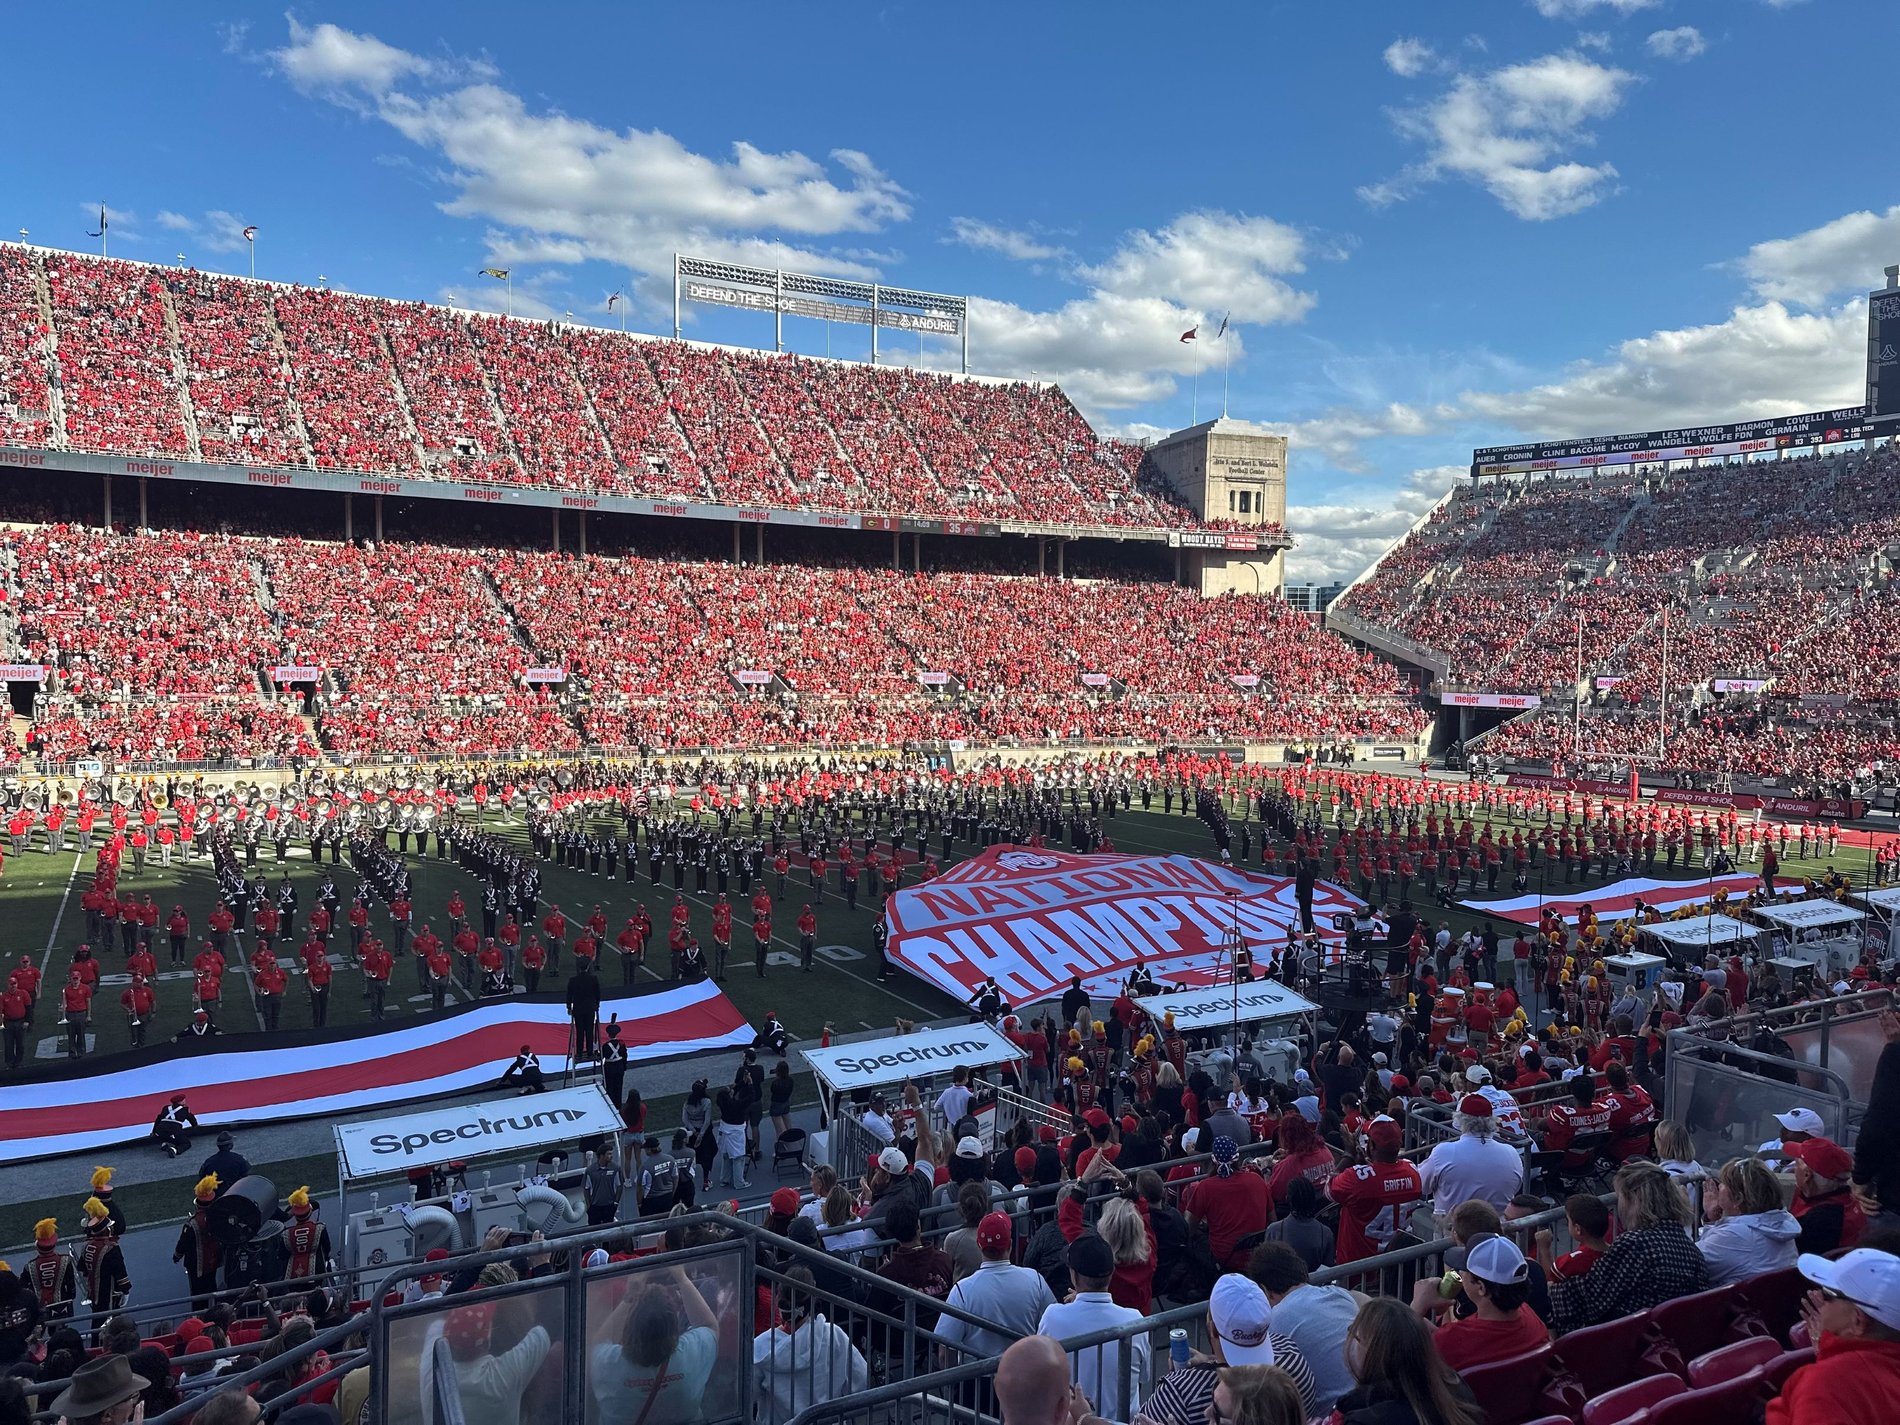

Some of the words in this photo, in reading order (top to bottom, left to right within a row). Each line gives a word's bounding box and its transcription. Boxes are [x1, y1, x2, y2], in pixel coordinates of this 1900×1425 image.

[690, 284, 737, 304] DEFEND
[739, 292, 762, 306] THE
[1872, 296, 1900, 309] DEFEN
[1881, 304, 1899, 313] THE
[912, 317, 956, 332] ANDURIL
[1832, 407, 1866, 419] WELLS
[1786, 413, 1825, 426] COVELLI
[1735, 420, 1775, 433] HARMON
[1765, 423, 1809, 436] GERMAIN
[1617, 433, 1648, 441] DIAMOND
[1662, 431, 1679, 440] LES
[1681, 427, 1724, 438] WEXNER
[1699, 433, 1733, 443] WOLFE
[1734, 431, 1753, 440] FDN
[1810, 435, 1823, 444] 393
[1611, 442, 1641, 451] McCOY
[1647, 437, 1693, 448] WANDELL
[1739, 440, 1769, 451] meijer
[1542, 449, 1566, 458] CLINE
[1570, 445, 1607, 455] BACOME
[1631, 451, 1660, 461] meijer
[1684, 446, 1715, 457] meijer
[1475, 455, 1497, 463] AUER
[1503, 452, 1533, 461] CRONIN
[1580, 455, 1607, 465] meijer
[126, 460, 174, 479] meijer
[1485, 463, 1510, 473] meijer
[1531, 460, 1558, 469] meijer
[247, 471, 292, 487] meijer
[360, 479, 402, 495] meijer
[464, 487, 503, 502] meijer
[562, 495, 598, 509] meijer
[653, 502, 687, 516] meijer
[738, 509, 770, 522] meijer
[818, 515, 849, 528] meijer
[883, 518, 890, 529] 0
[949, 522, 961, 534] 35
[1181, 534, 1202, 543] WOODY
[1205, 535, 1225, 544] HAYES
[0, 667, 38, 679] meijer
[280, 669, 314, 681] meijer
[531, 670, 559, 682] meijer
[742, 672, 766, 683] meijer
[1084, 675, 1107, 684] meijer
[1454, 693, 1480, 704] meijer
[1499, 695, 1526, 706] meijer
[1513, 777, 1540, 786] DEFEND
[1603, 786, 1630, 795] ANDURI
[1663, 791, 1693, 801] DEFEND
[1694, 795, 1709, 803] THE
[1775, 803, 1810, 813] ANDURIL
[1820, 808, 1846, 818] Allstate
[911, 860, 1245, 922] NATIONAL
[1868, 935, 1887, 956] STATE
[1164, 992, 1279, 1021] Spectrum
[834, 1040, 984, 1075] Spectrum
[370, 1108, 578, 1155] Spectrum
[654, 1161, 671, 1171] BEST
[1383, 1177, 1413, 1192] GRIFFIN
